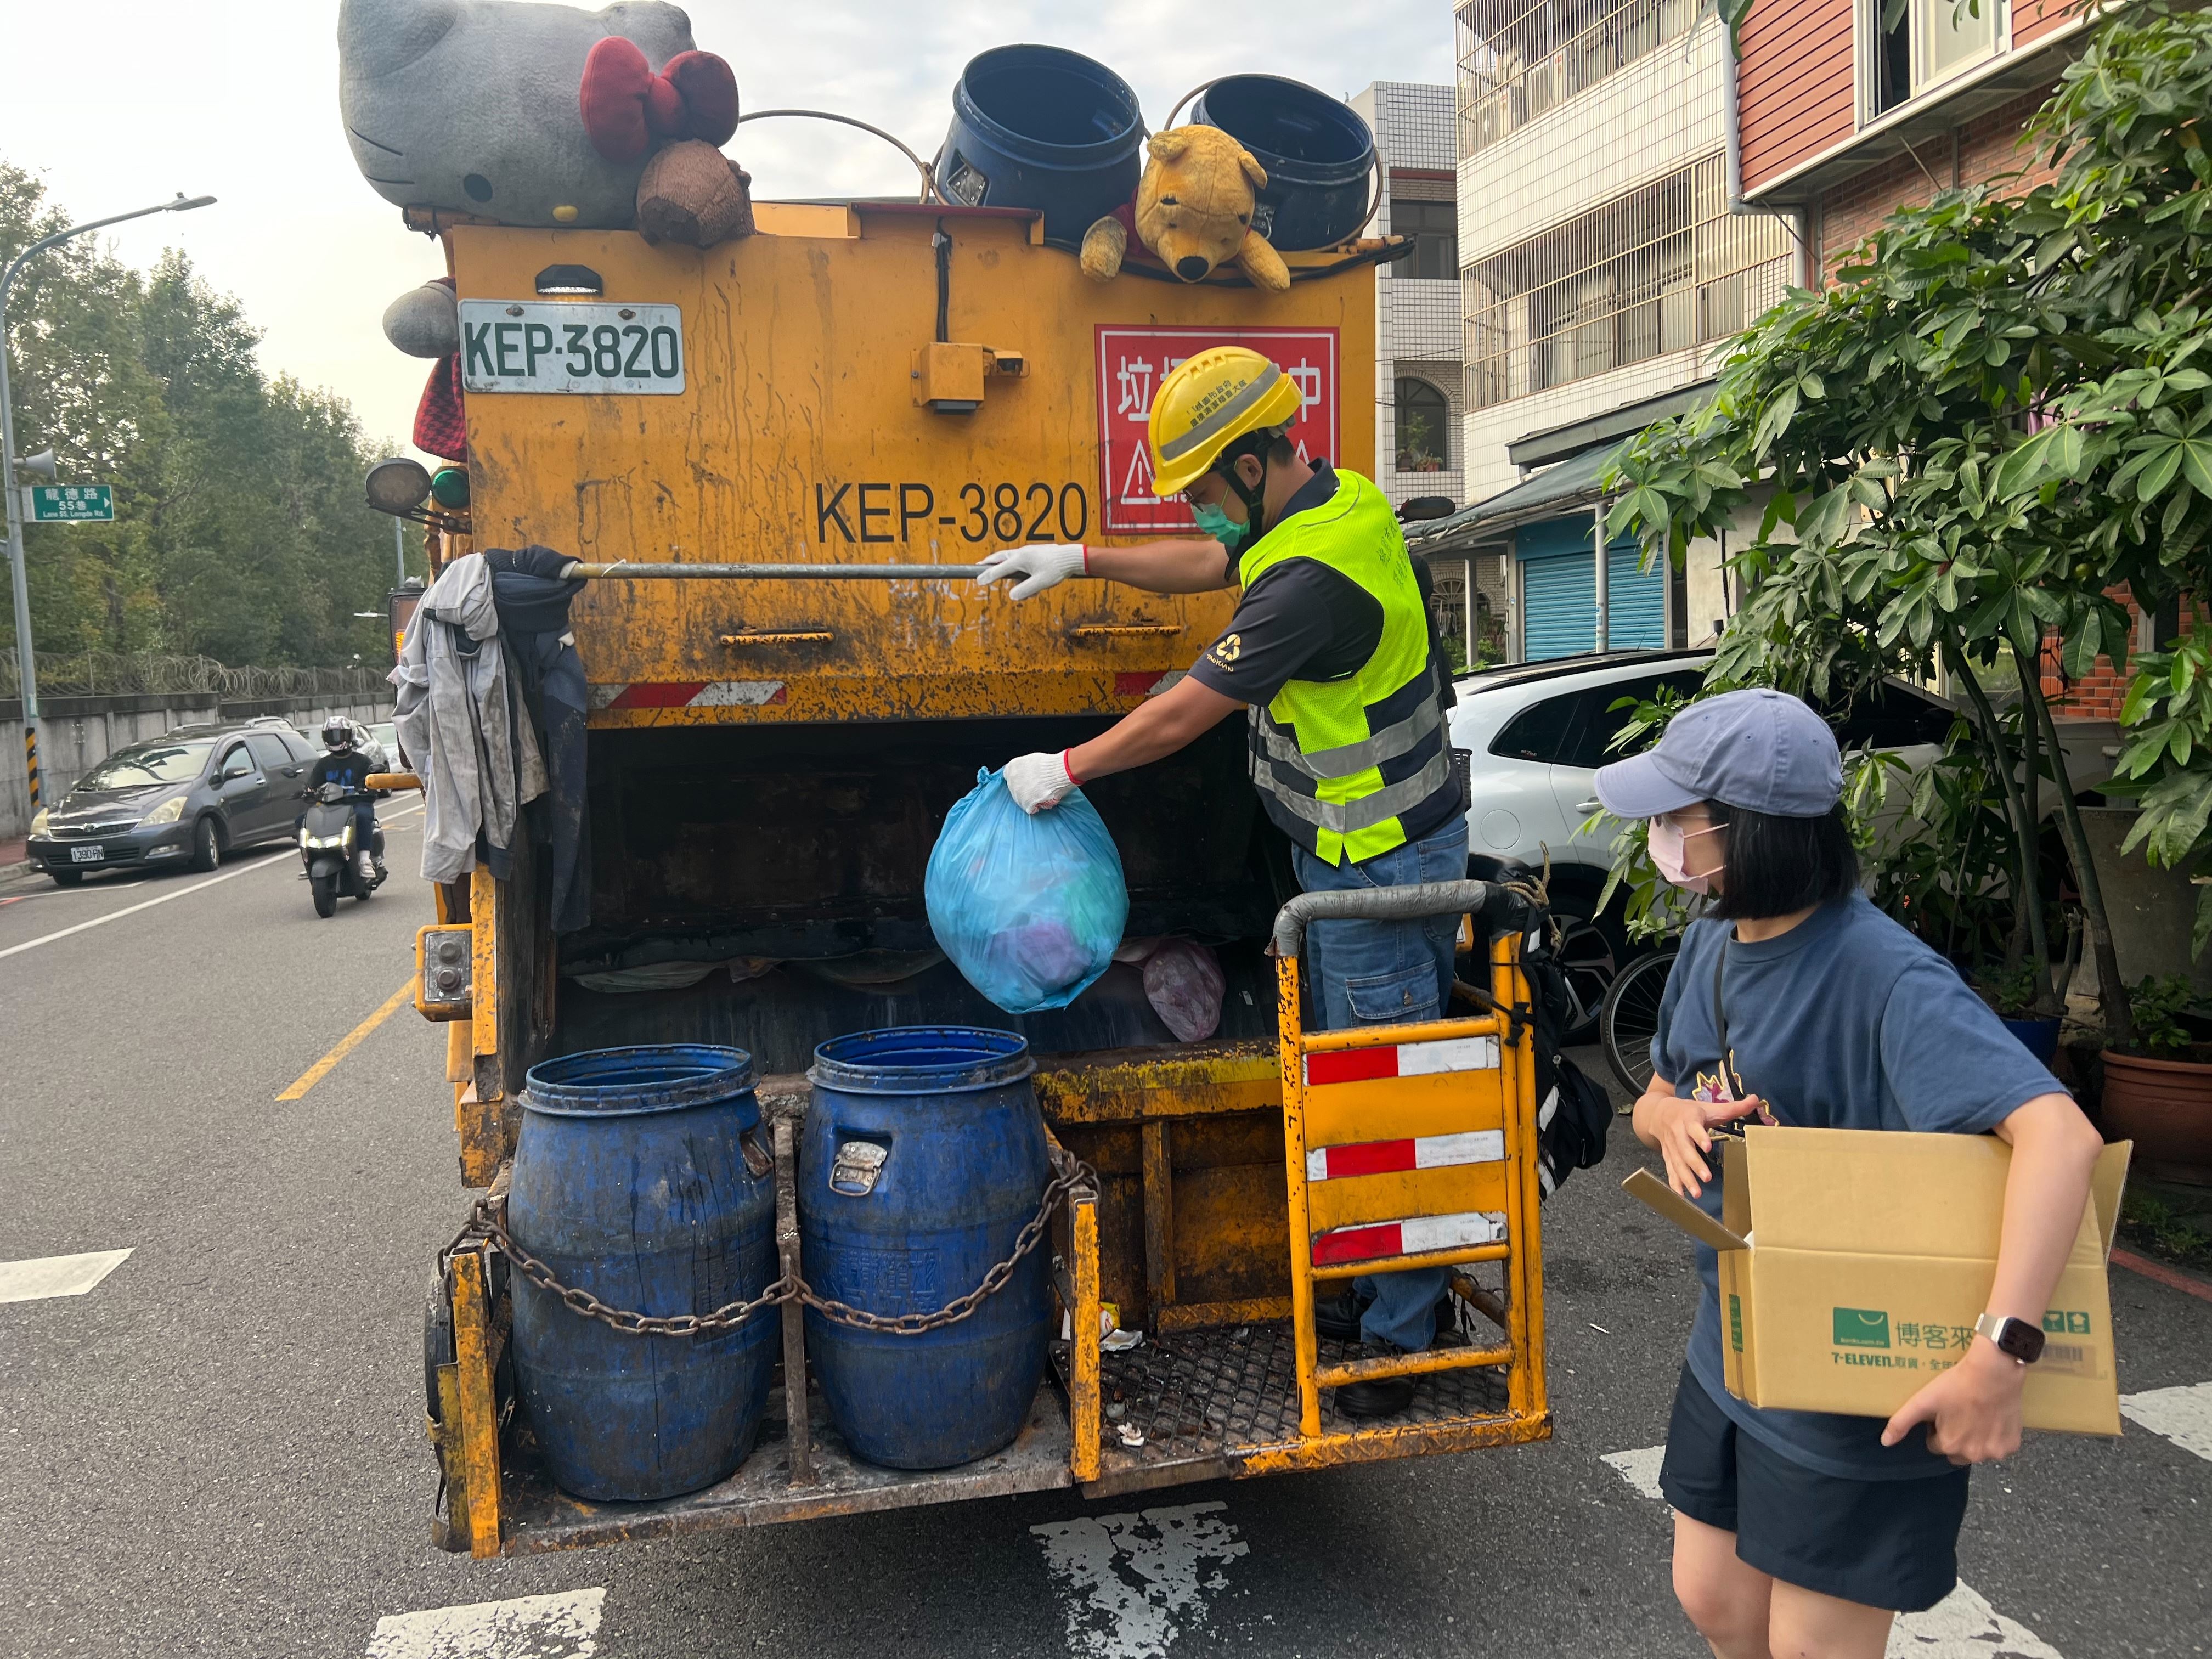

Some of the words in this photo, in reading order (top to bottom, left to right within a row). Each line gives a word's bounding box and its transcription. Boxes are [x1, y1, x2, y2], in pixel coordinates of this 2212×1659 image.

[44, 488, 98, 501] 龍德路
[59, 500, 87, 510] 55巷
[816, 482, 1087, 543] KEP-3820
[1206, 653, 1234, 673] TAOYUAN
[1895, 1321, 1974, 1351] 博客來
